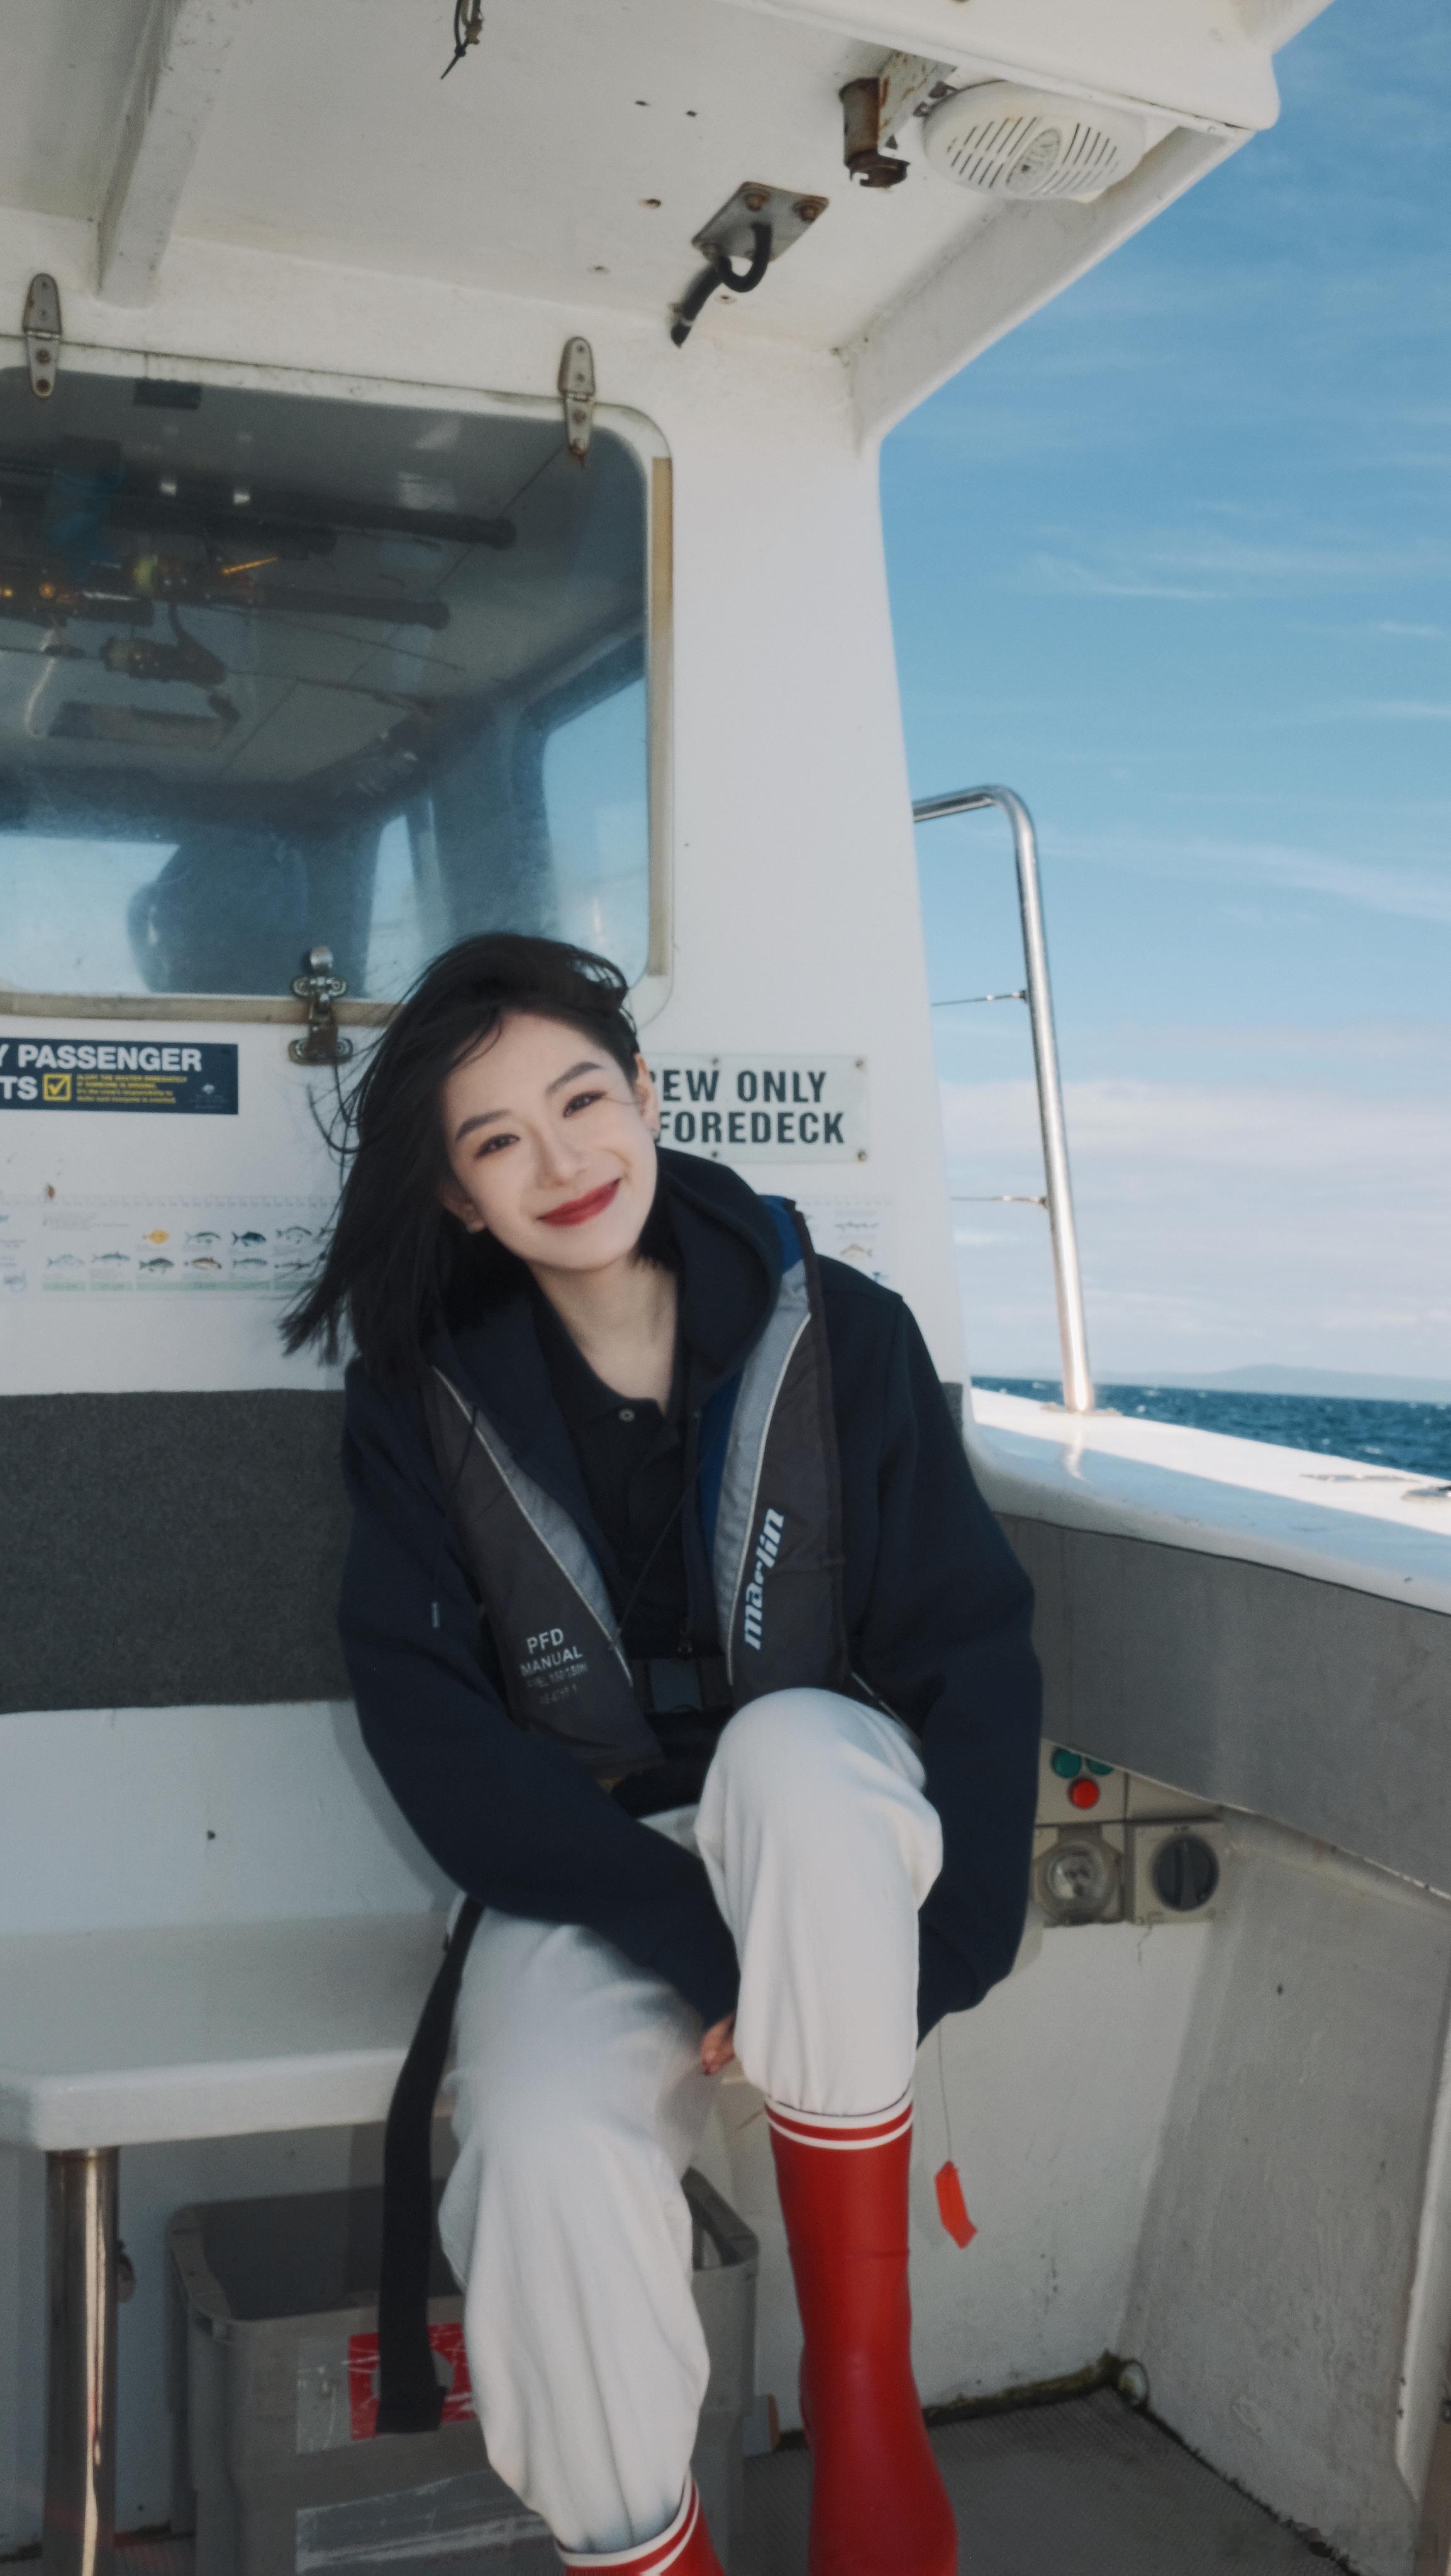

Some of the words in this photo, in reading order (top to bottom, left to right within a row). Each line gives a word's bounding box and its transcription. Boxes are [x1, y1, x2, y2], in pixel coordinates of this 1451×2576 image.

[18, 1045, 203, 1072] PASSENGER
[650, 1070, 719, 1102] EW
[737, 1070, 826, 1103] ONLY
[744, 1508, 785, 1651] marlin
[526, 1628, 564, 1655] PFD
[520, 1646, 584, 1677] MANUAL
